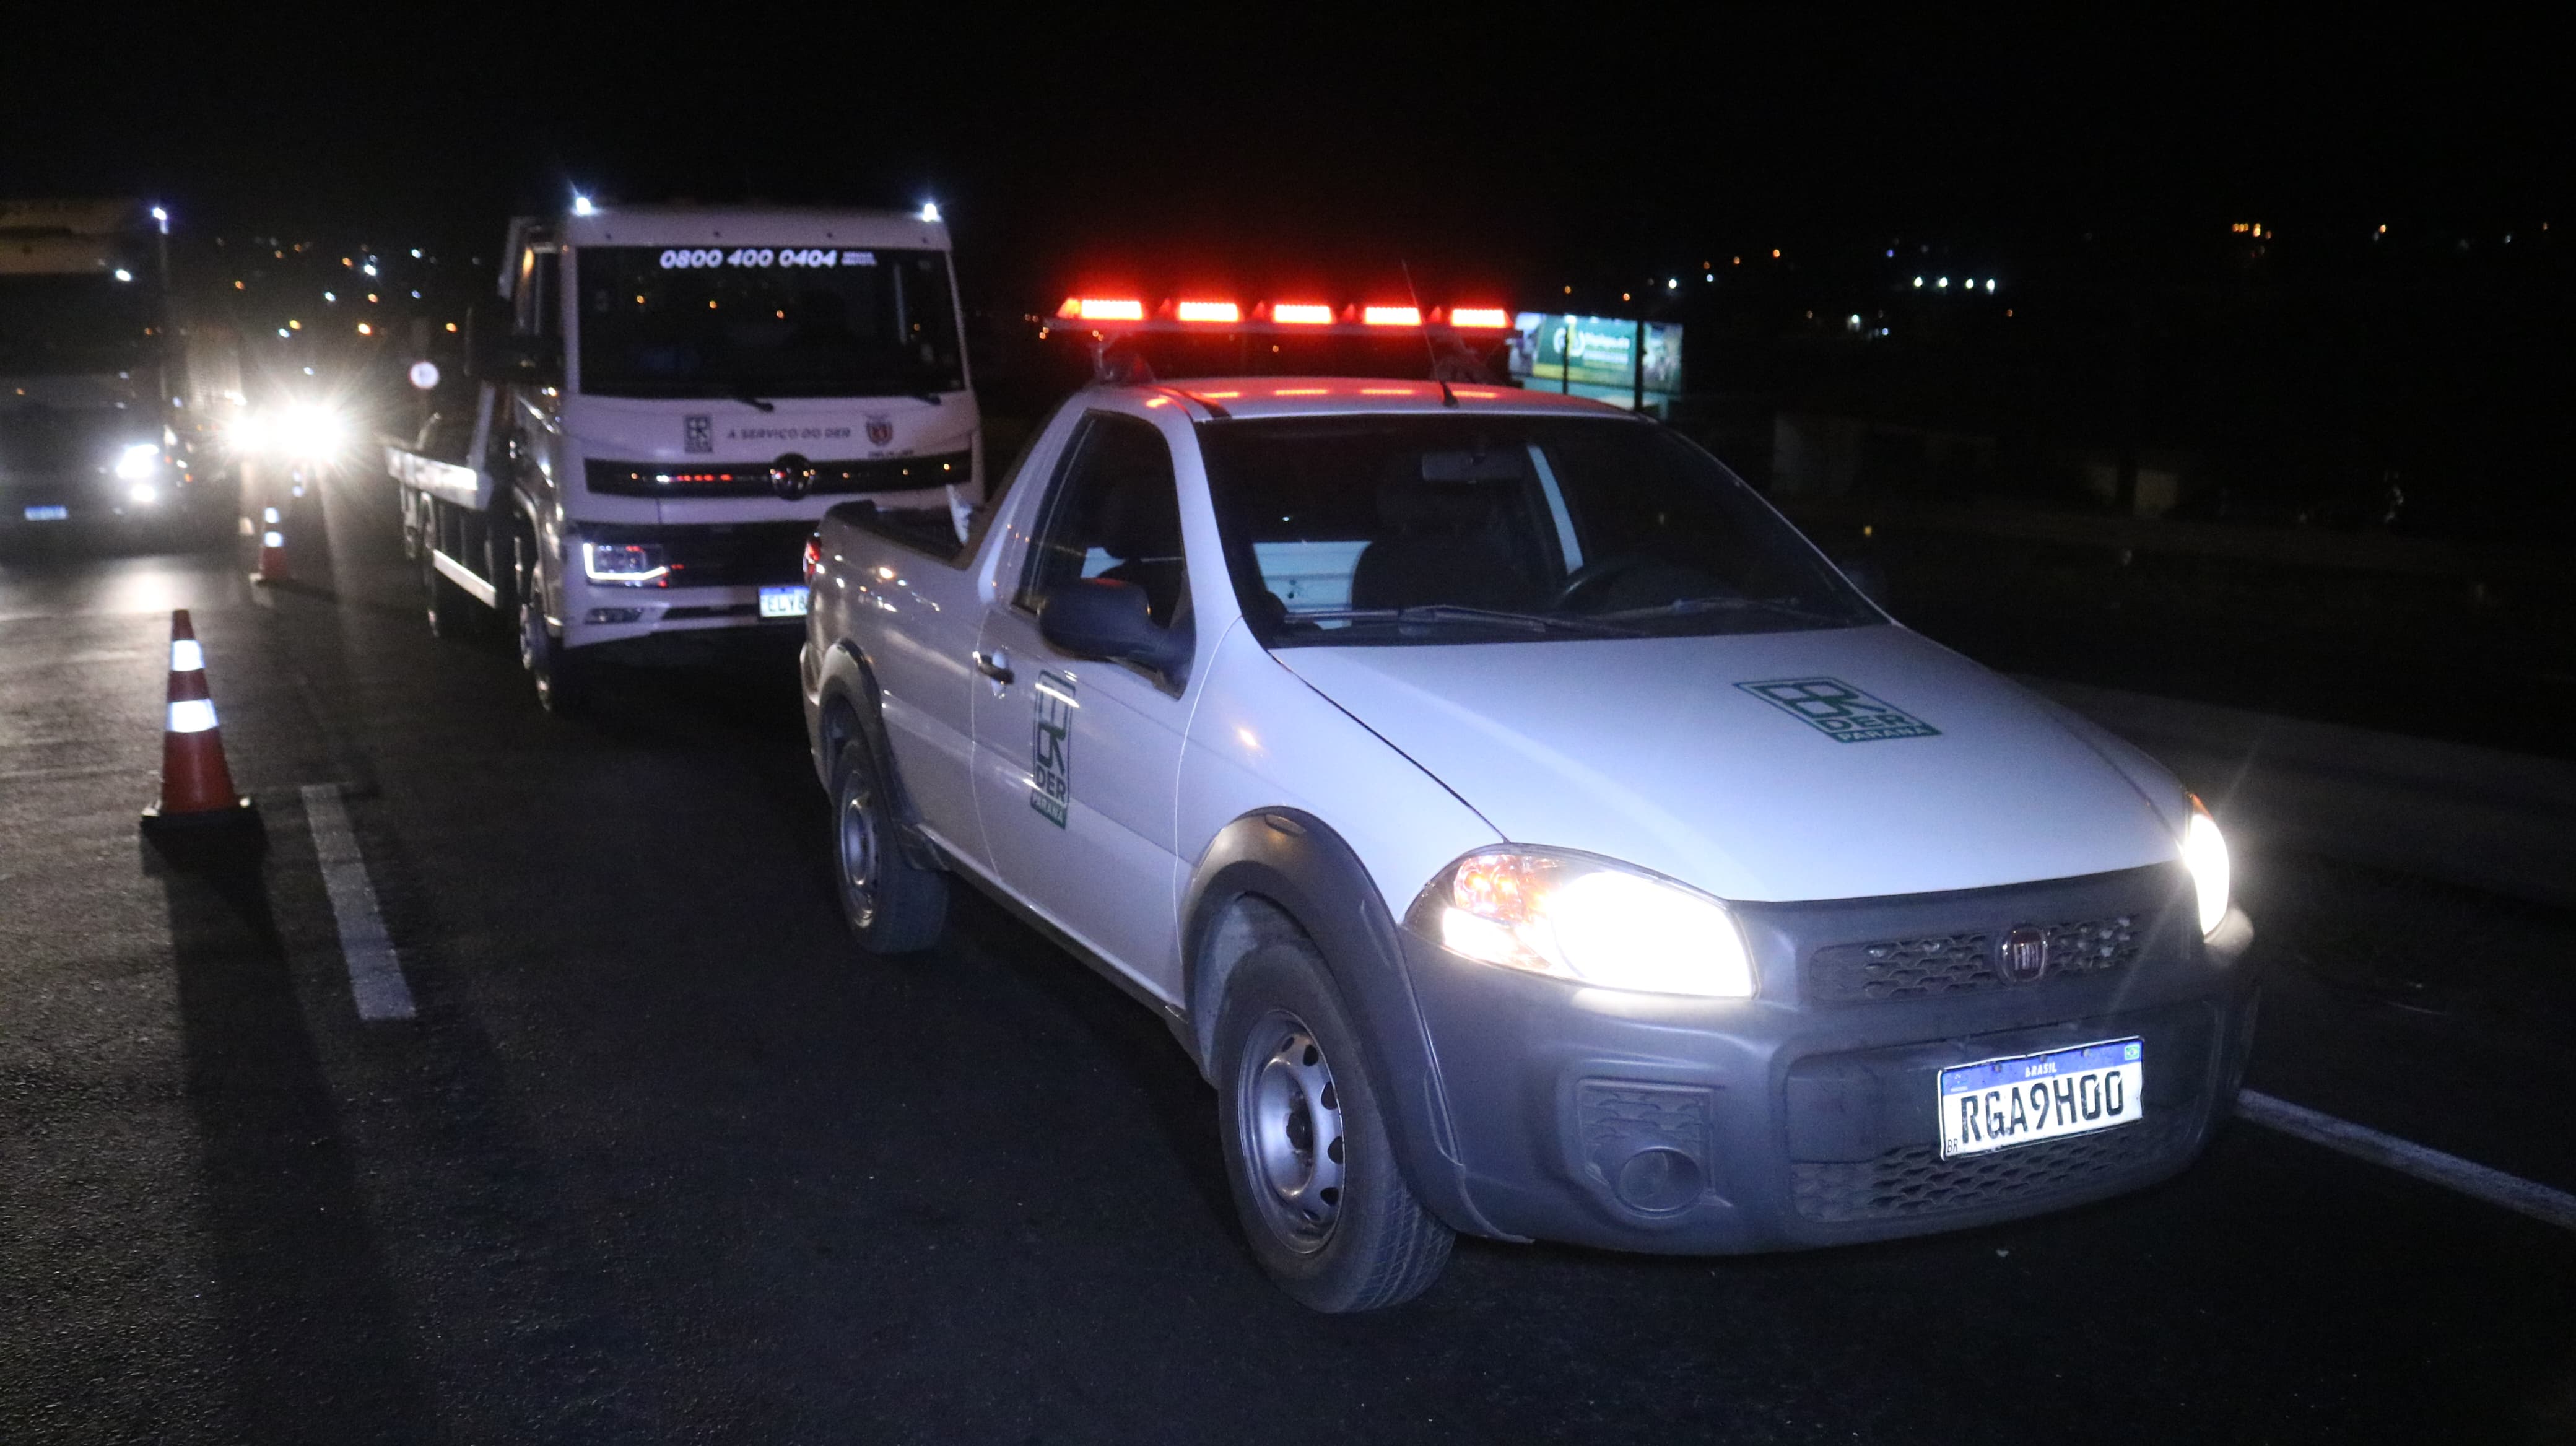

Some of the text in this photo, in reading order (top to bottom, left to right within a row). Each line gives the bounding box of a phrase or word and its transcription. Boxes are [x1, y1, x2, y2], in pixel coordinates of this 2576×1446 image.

[659, 250, 723, 269] 0800
[727, 249, 774, 267] 400
[778, 249, 837, 268] 0404
[727, 429, 736, 439] A
[801, 428, 821, 439] DO
[825, 427, 851, 438] DER
[1815, 715, 1922, 731] DER
[1036, 764, 1066, 803] DER
[2025, 1062, 2057, 1078] BRASIL
[1960, 1071, 2124, 1144] RGA9H00
[1947, 1138, 1957, 1153] BR
